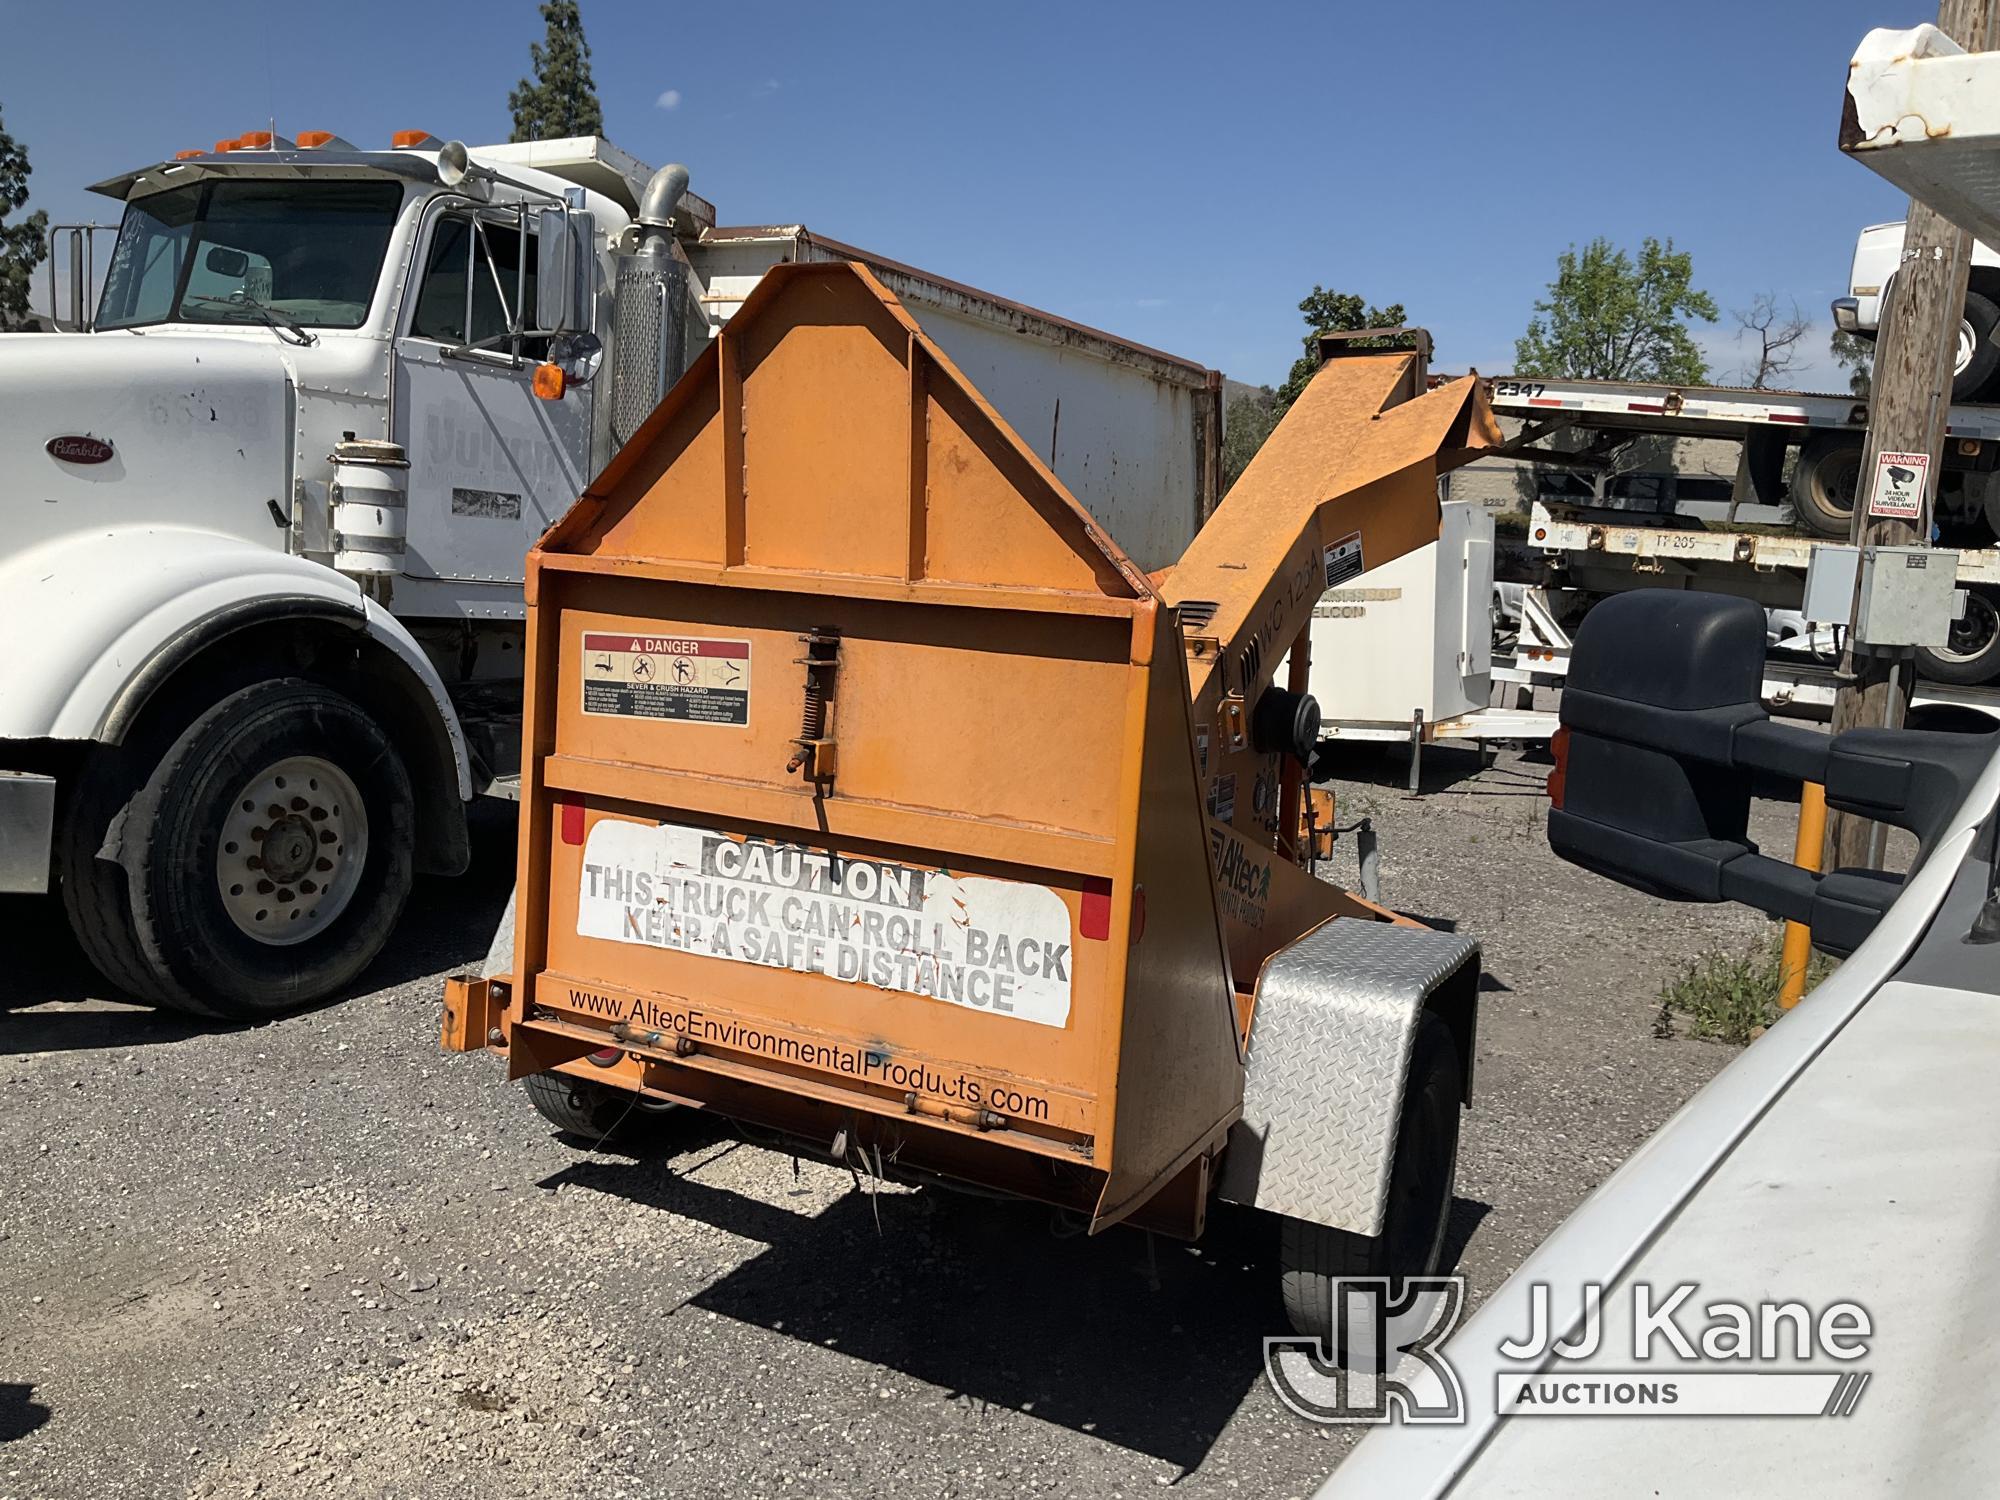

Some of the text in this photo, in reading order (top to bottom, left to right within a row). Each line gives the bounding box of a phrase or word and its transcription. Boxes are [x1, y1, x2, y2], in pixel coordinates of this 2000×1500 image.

[1497, 382, 1545, 397] 2347
[54, 440, 107, 457] Peterbilt
[1881, 455, 1926, 465] WARNING
[1673, 536, 1696, 549] 205
[1260, 600, 1283, 652] WC
[645, 639, 699, 654] DANGER
[626, 683, 648, 691] SEVER
[680, 686, 709, 695] HAZARD
[714, 842, 910, 906] CAUTION
[1217, 838, 1260, 899] Altec
[585, 864, 1068, 982] THIS TRUCK CAN ROLL BACK
[623, 907, 1014, 1012] KEEP A SAFE DISTANCE
[569, 989, 1049, 1119] www.AltecEnvironmentalProducts.com
